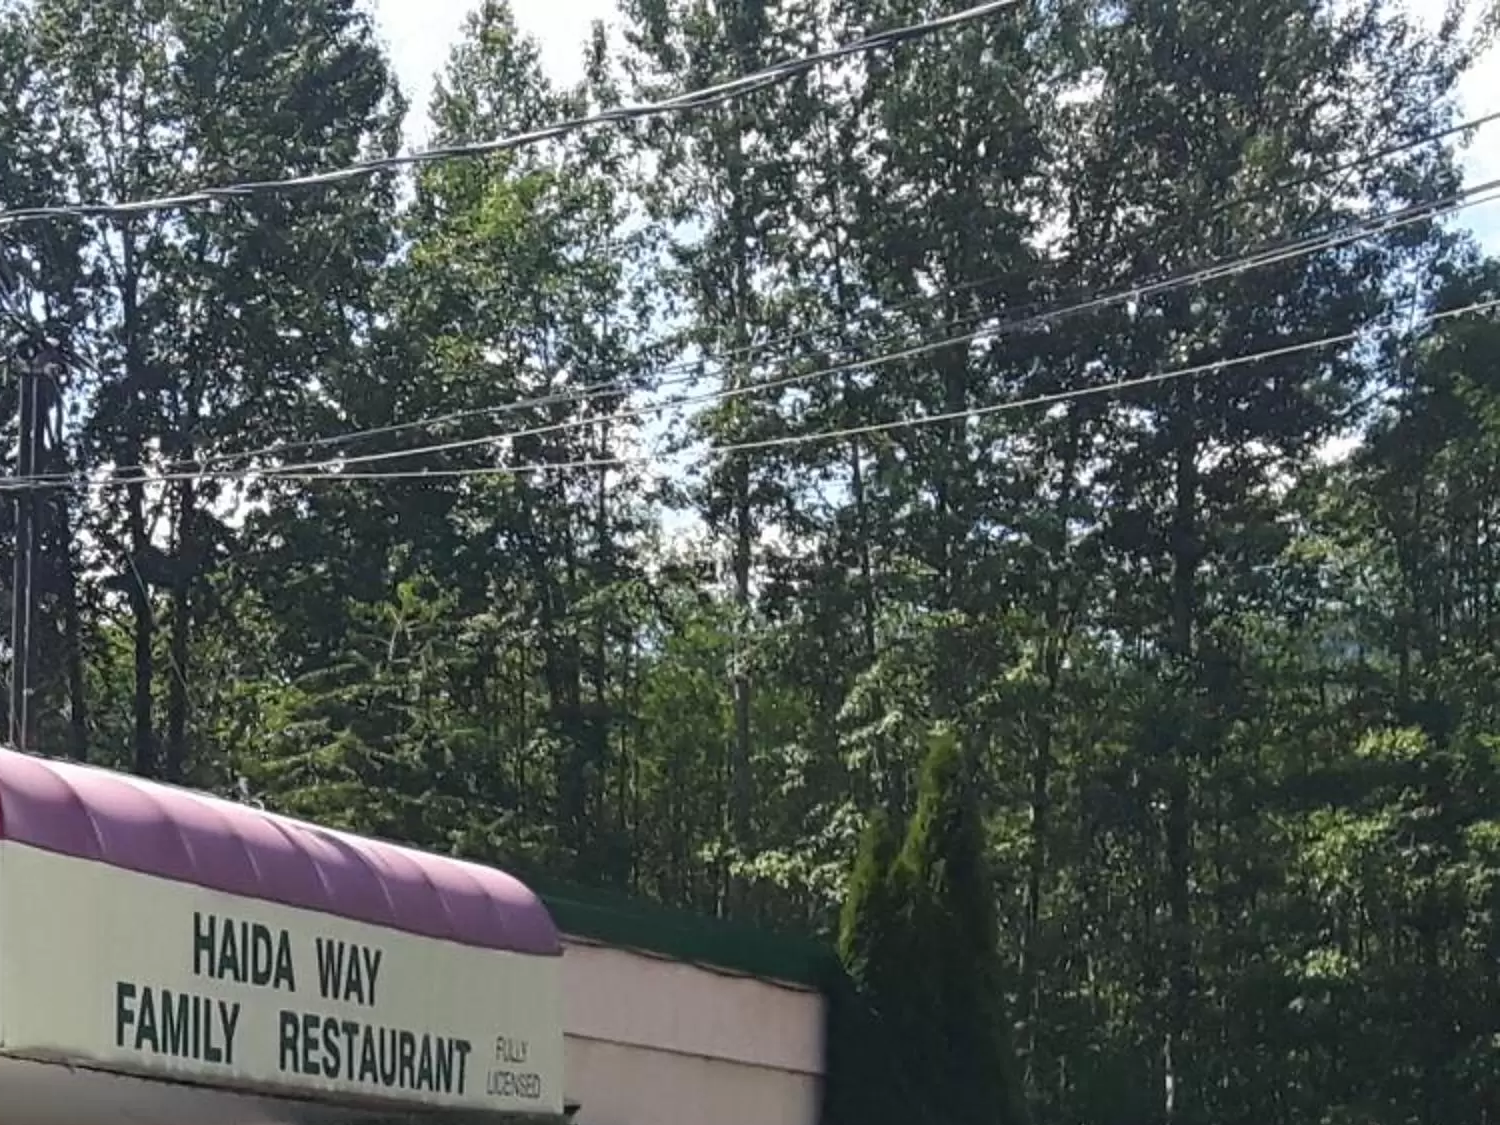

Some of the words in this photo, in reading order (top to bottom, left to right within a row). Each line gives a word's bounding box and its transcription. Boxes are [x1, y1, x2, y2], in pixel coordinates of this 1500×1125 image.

[192, 912, 296, 993] HAIDA
[316, 936, 383, 1007] WAY
[115, 981, 241, 1065] FAMILY
[279, 1010, 473, 1096] RESTAURANT
